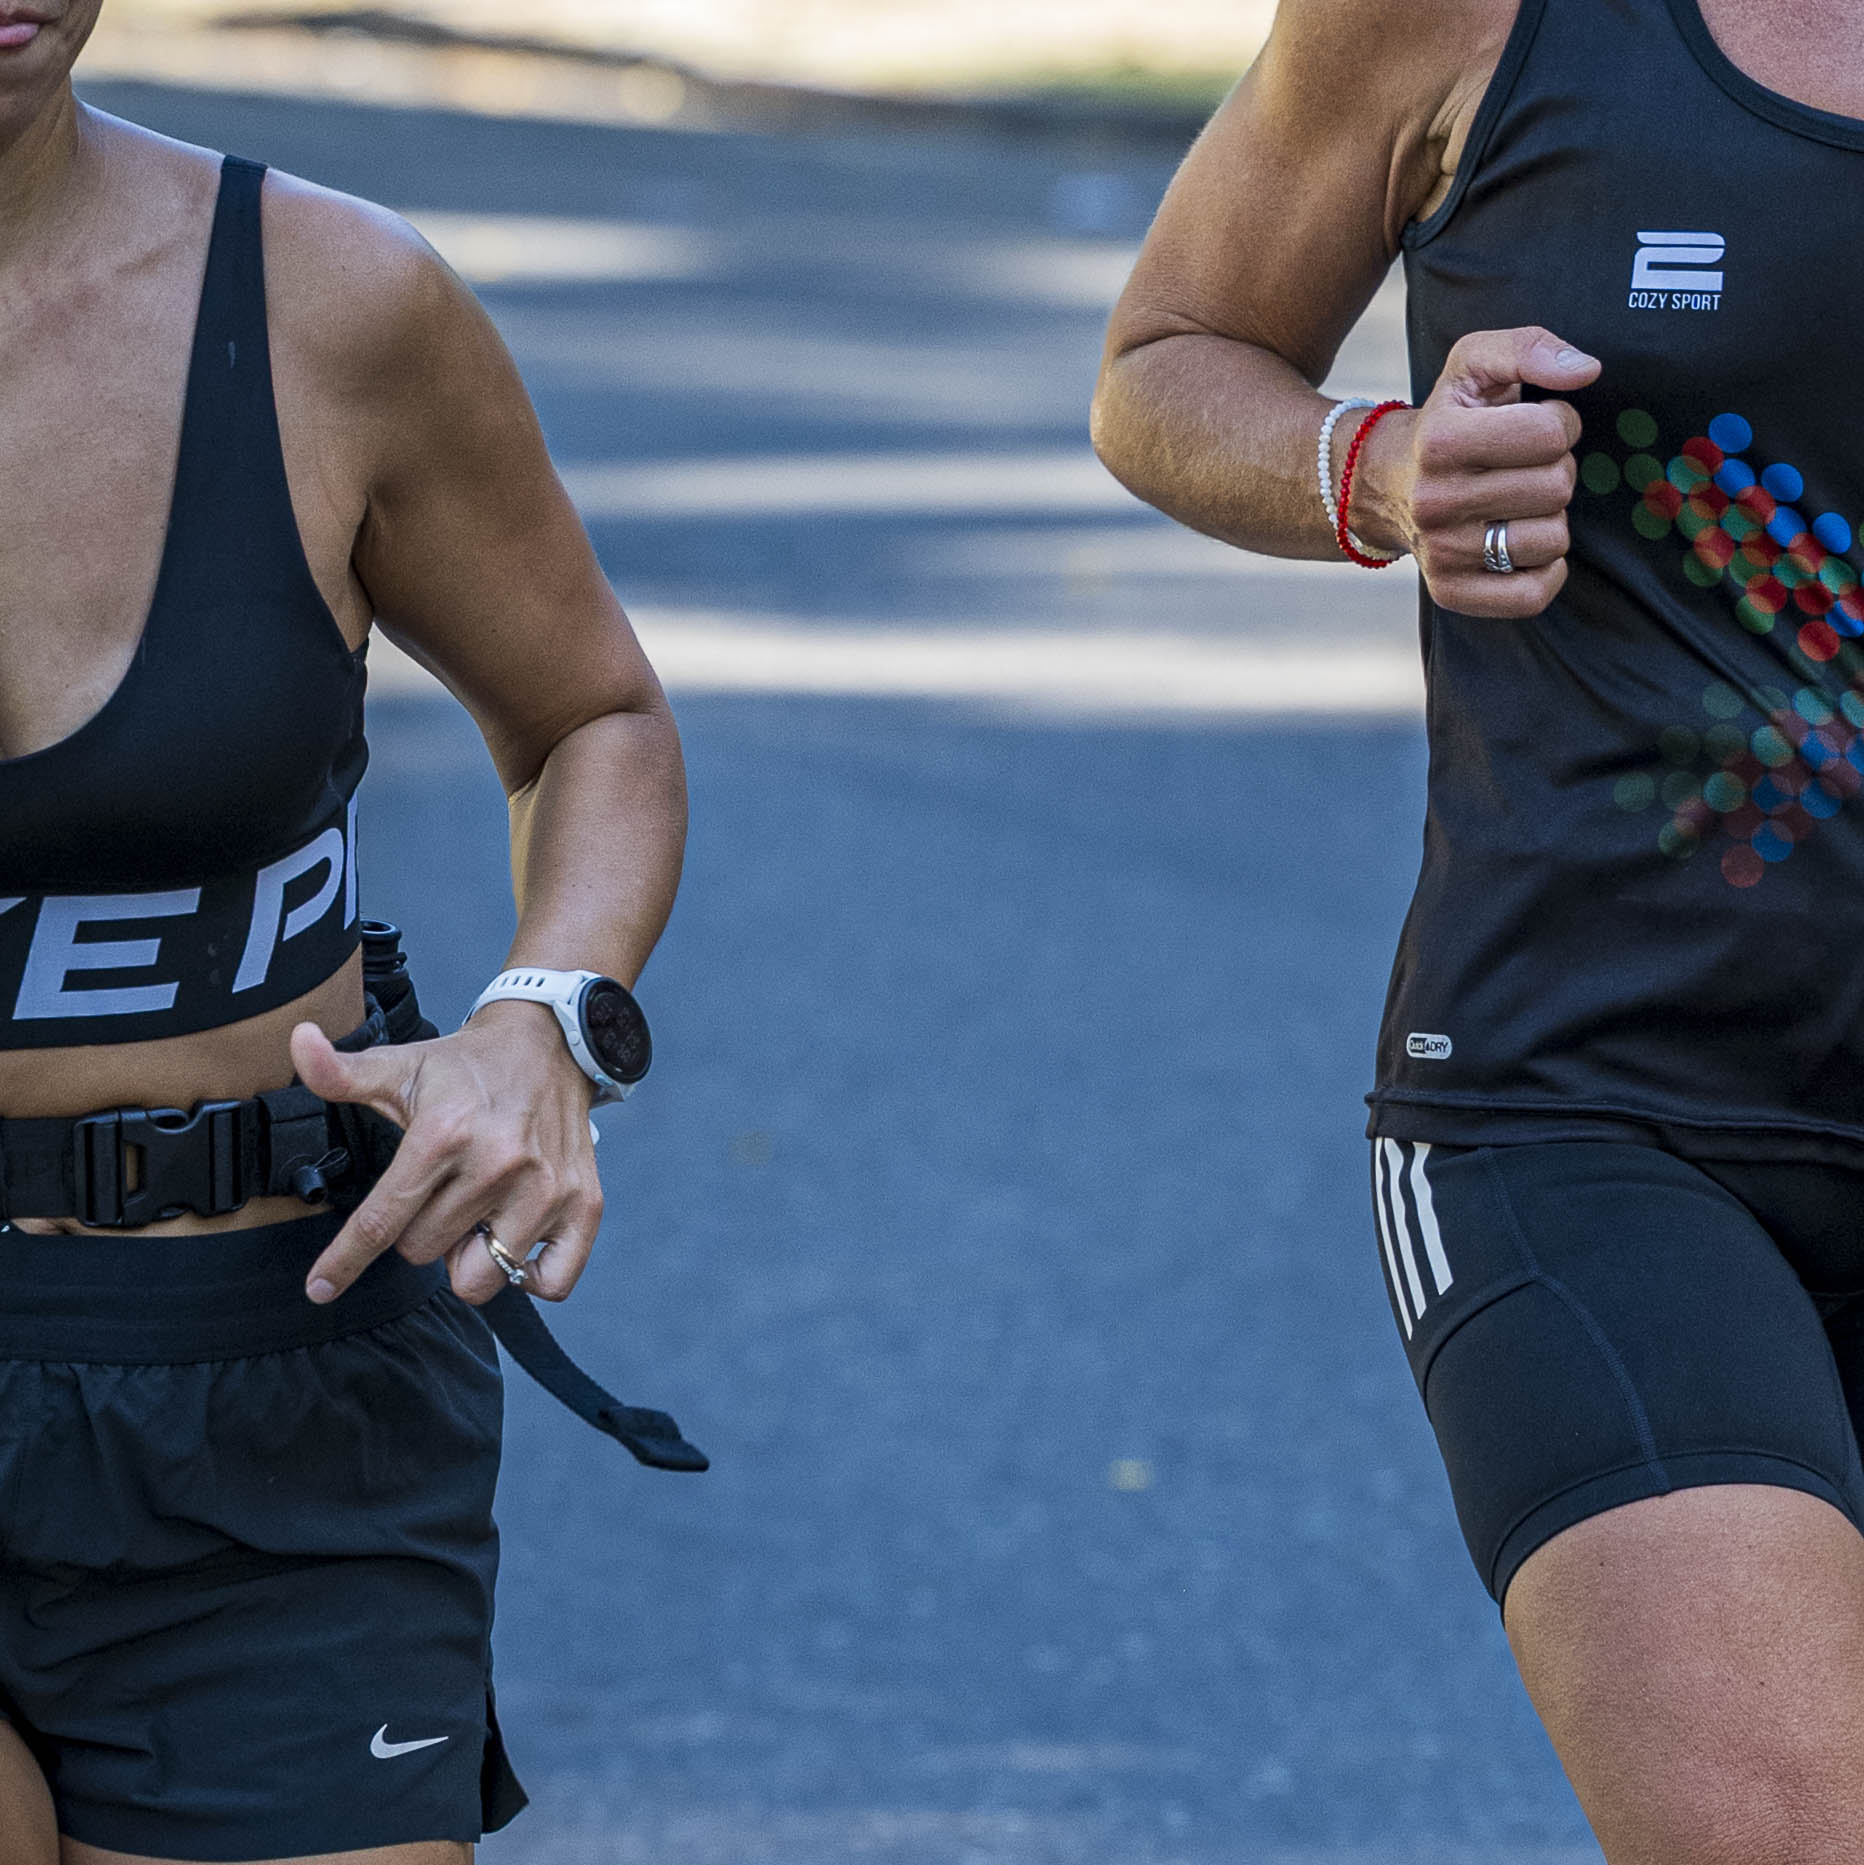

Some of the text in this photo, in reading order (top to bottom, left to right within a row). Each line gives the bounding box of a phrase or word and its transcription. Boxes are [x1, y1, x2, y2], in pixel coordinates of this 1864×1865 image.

[1628, 291, 1721, 311] COZY SPORT
[0, 887, 201, 1020] E
